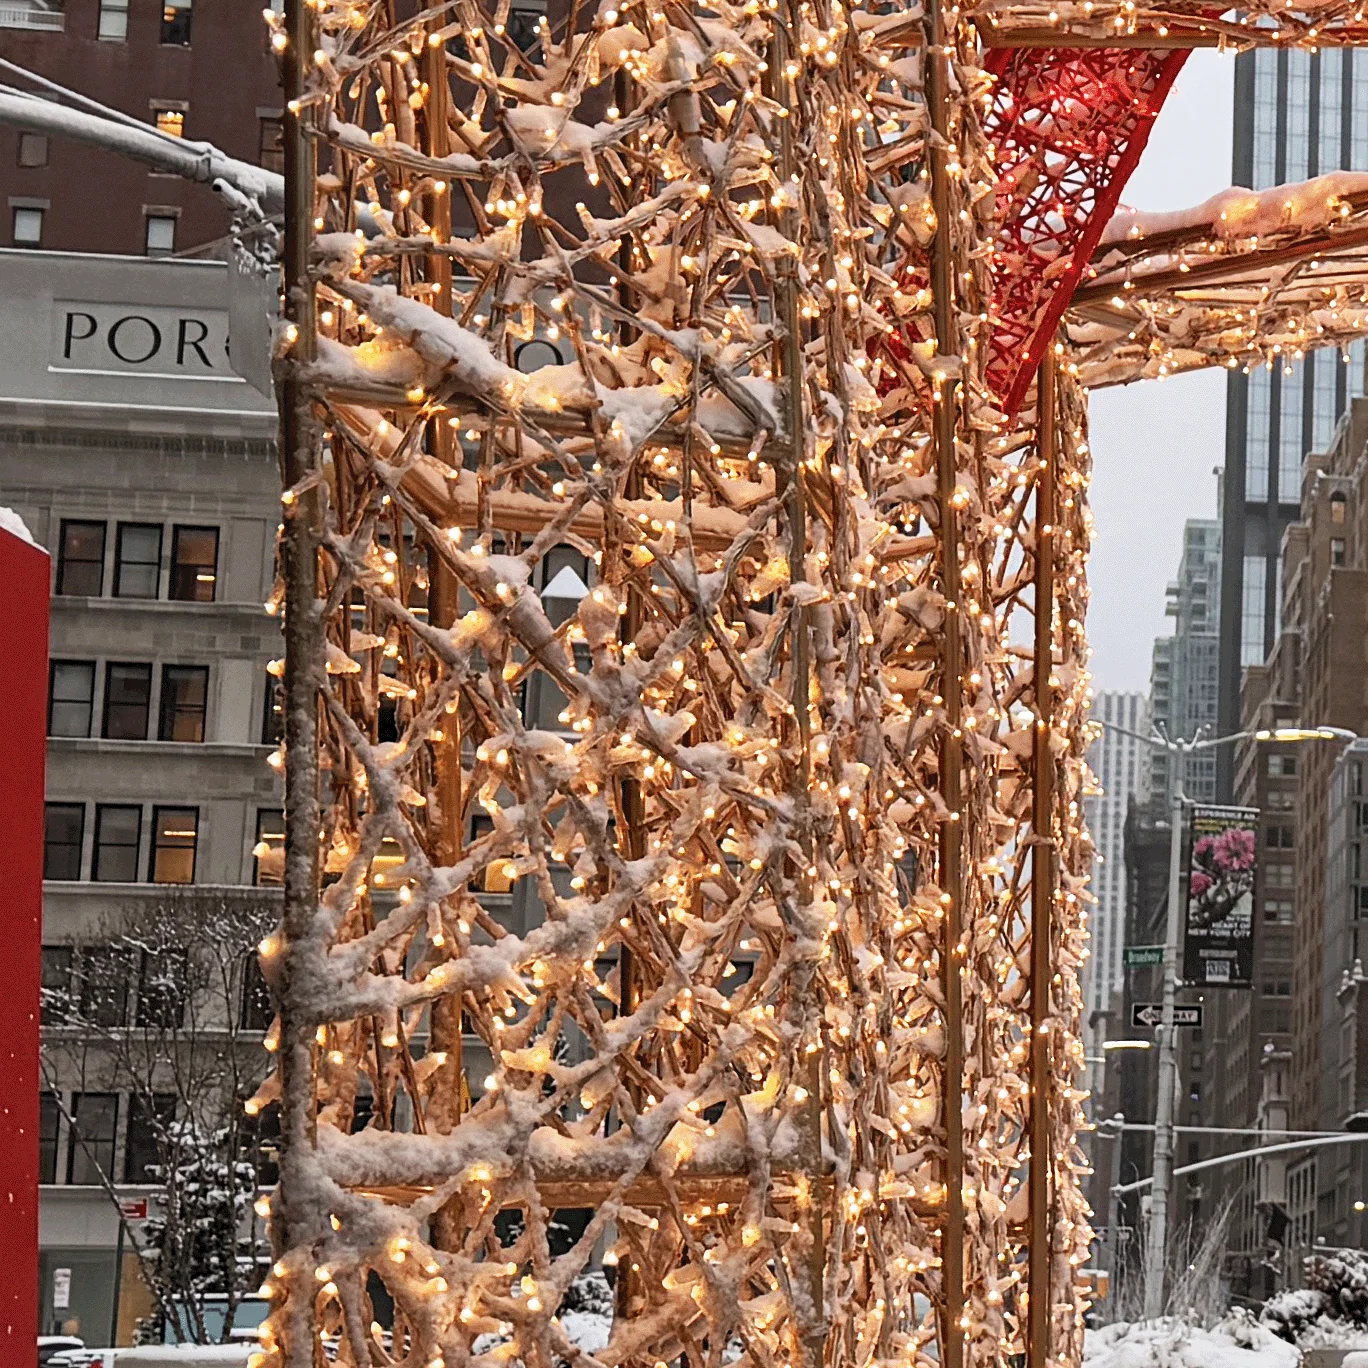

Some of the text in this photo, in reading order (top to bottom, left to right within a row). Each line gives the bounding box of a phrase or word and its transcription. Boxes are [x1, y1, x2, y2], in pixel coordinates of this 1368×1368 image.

[63, 312, 230, 368] POR
[1188, 928, 1252, 938] NEW YORK CITY
[1127, 950, 1161, 964] Broadway
